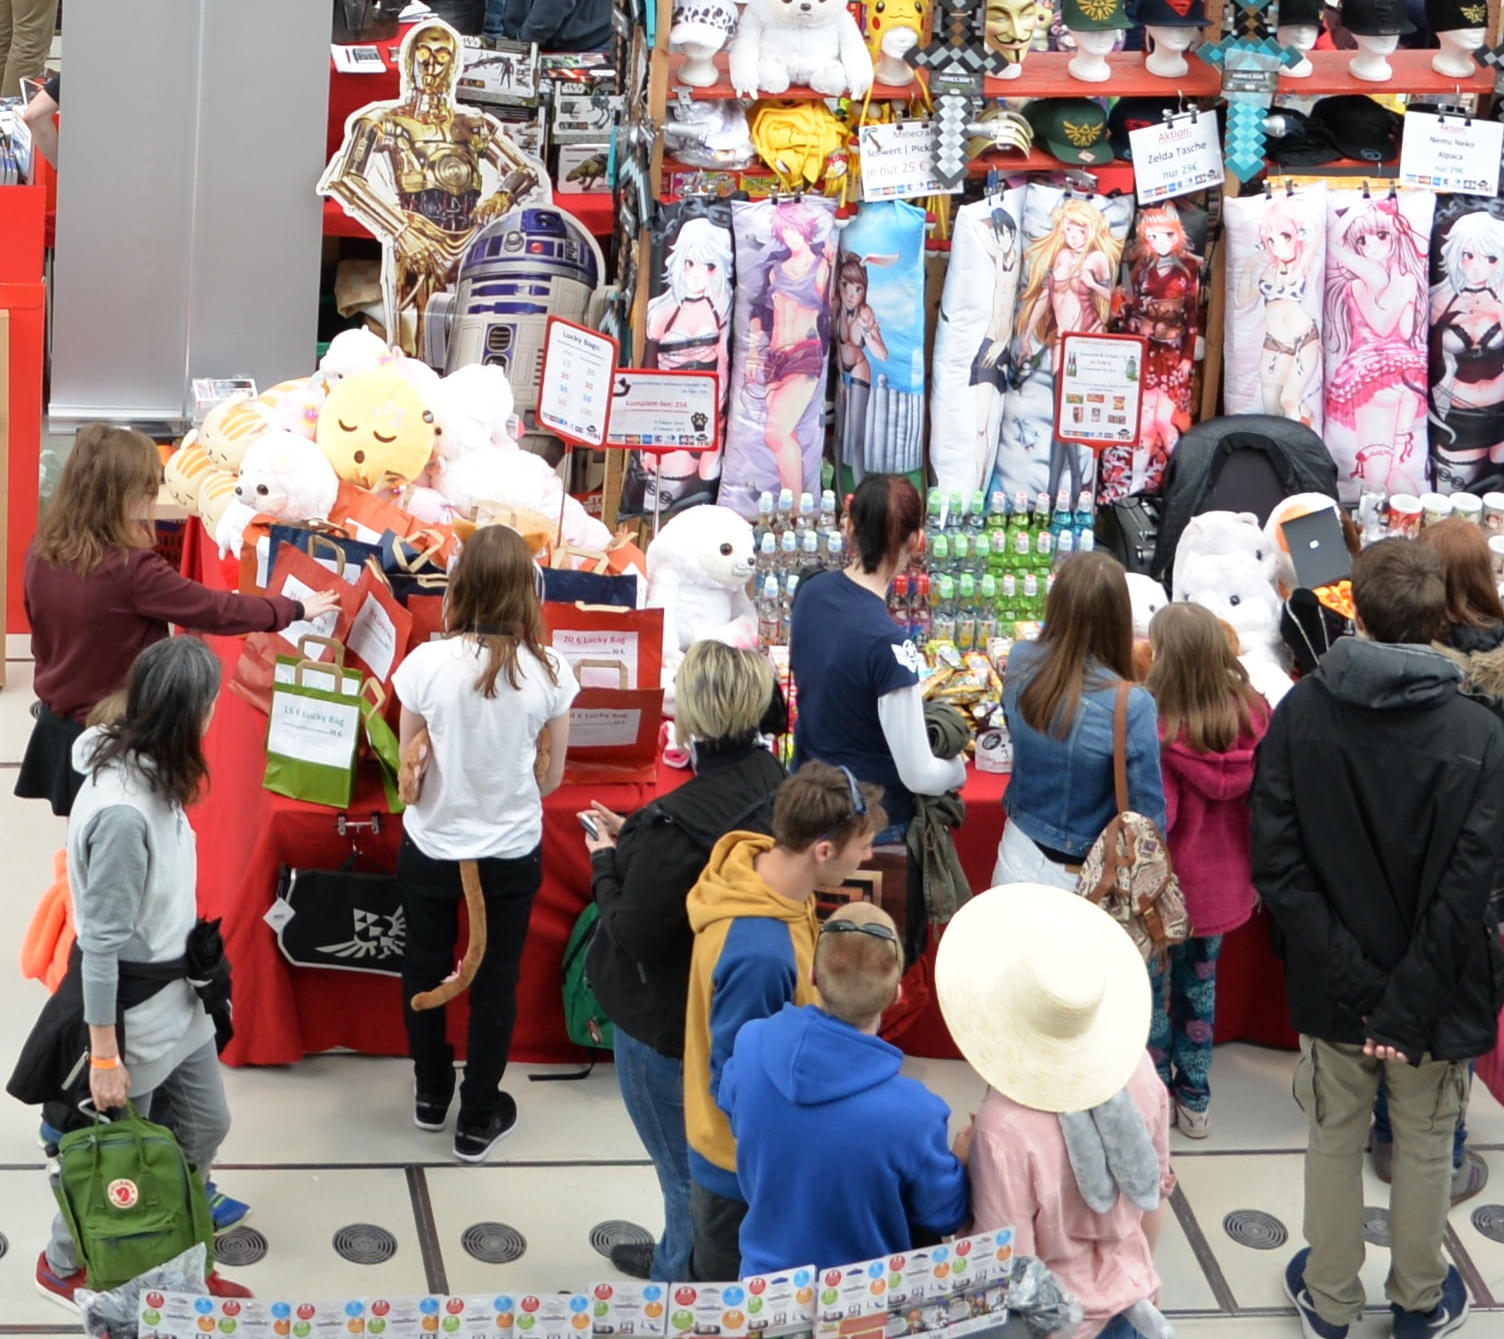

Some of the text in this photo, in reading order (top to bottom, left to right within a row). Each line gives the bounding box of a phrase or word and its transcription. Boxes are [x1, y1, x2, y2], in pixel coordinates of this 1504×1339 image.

[1158, 126, 1194, 143] Aktion:
[1429, 135, 1475, 149] Nemu Neko
[1147, 140, 1208, 165] Zelda Tasche
[1437, 151, 1464, 163] Alpaca
[883, 163, 898, 175] nur
[902, 161, 916, 174] 25
[918, 161, 927, 172] €
[1163, 162, 1198, 180] nur 29€
[562, 330, 582, 346] Lucky
[563, 634, 575, 644] 20
[583, 635, 608, 647] Lucky
[609, 636, 626, 647] Bag
[283, 705, 346, 727] 15 Lucky Bag
